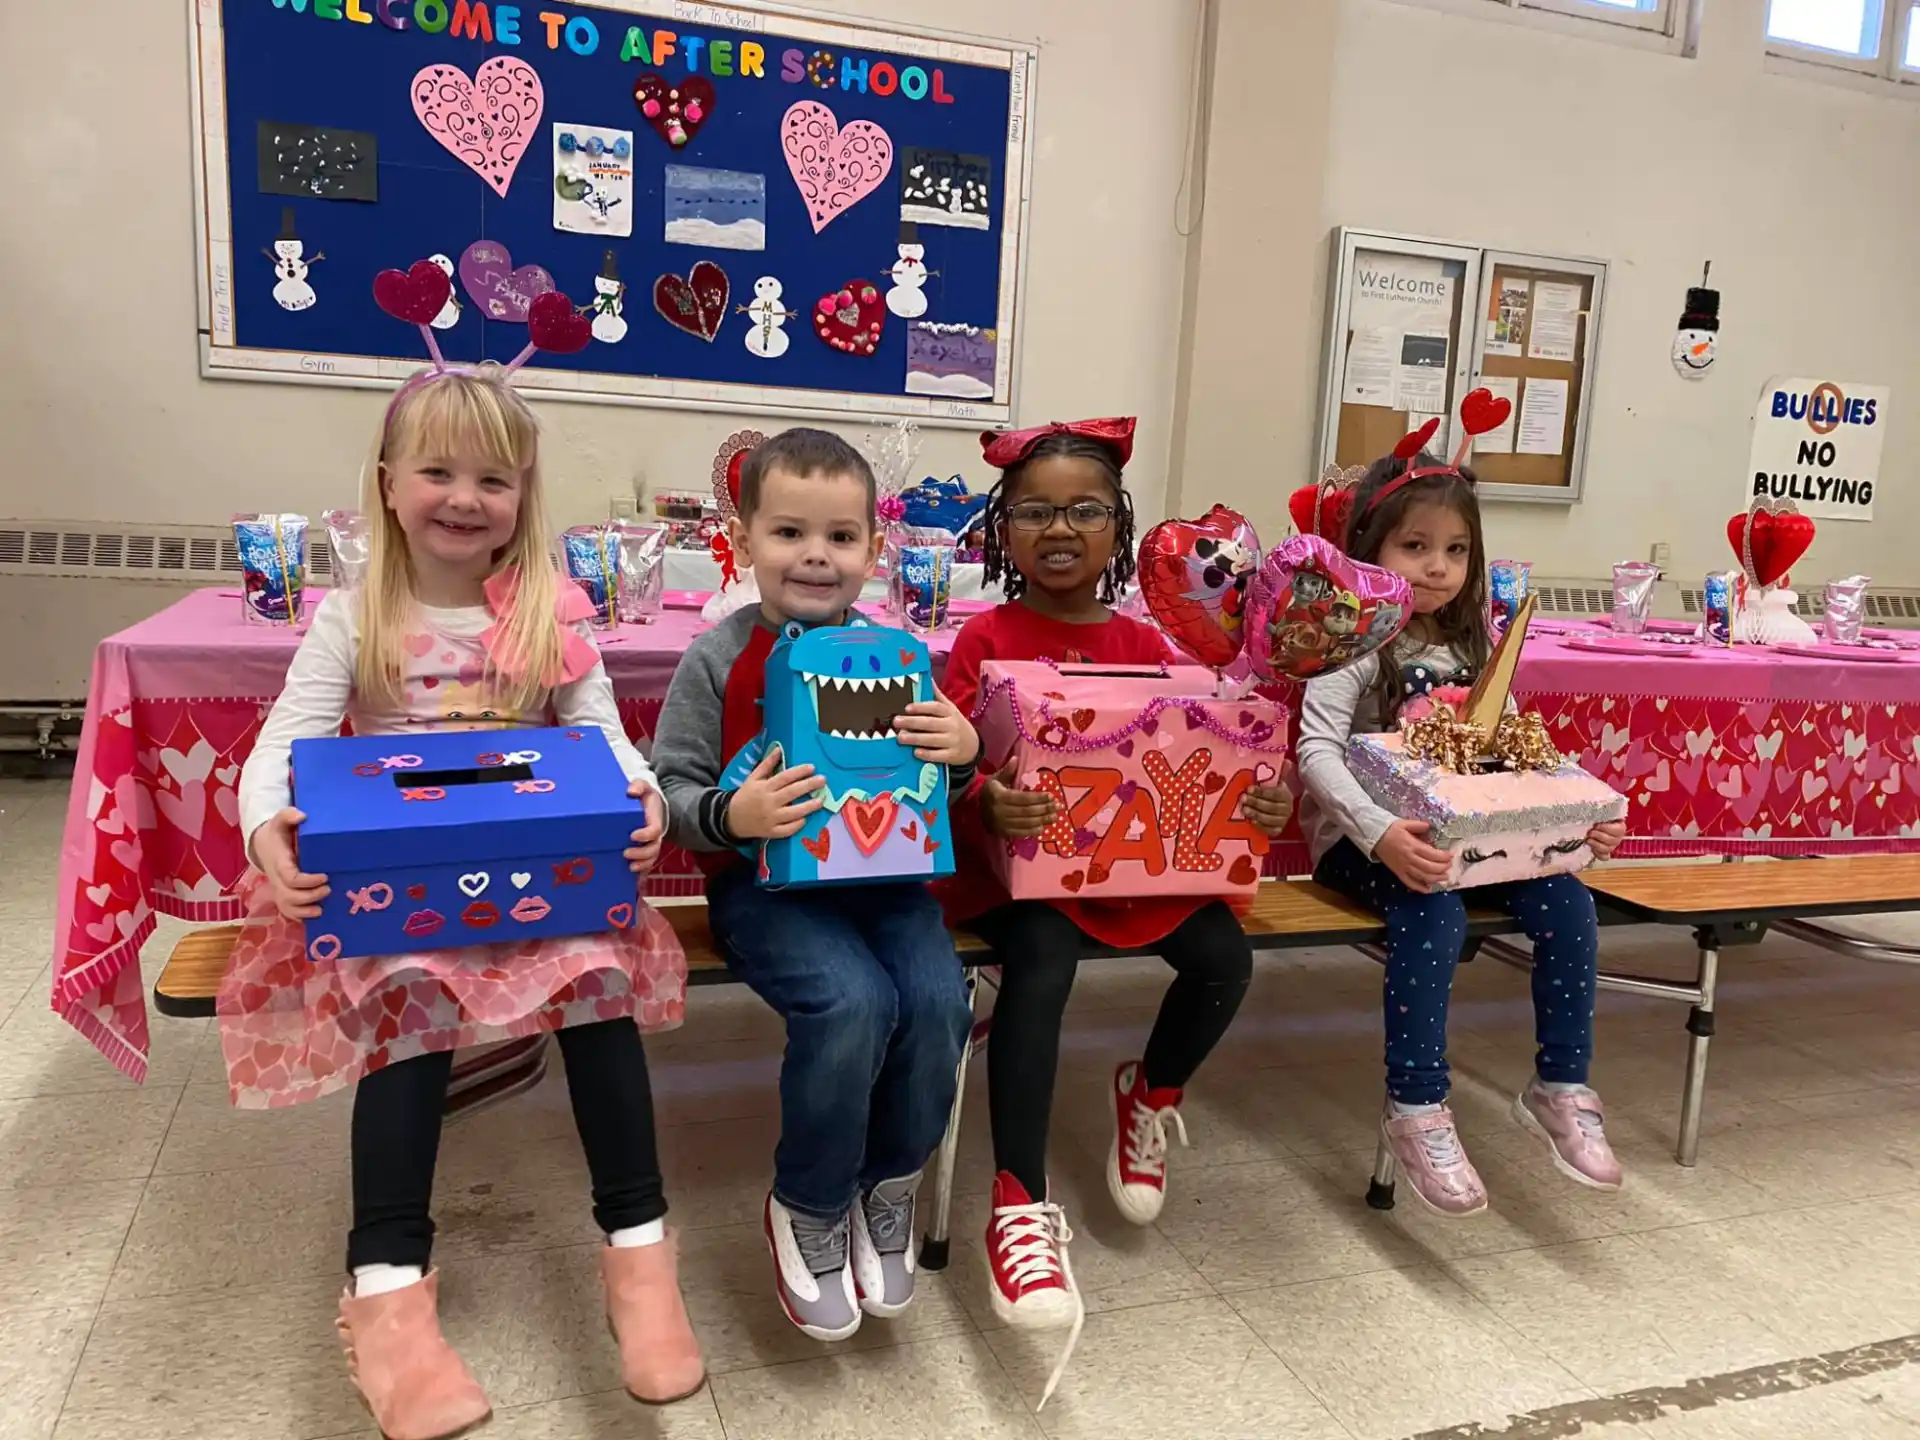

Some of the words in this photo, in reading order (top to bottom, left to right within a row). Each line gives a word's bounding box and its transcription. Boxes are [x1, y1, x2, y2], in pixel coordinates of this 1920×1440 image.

[540, 11, 599, 55] TO
[619, 26, 765, 78] AFTER
[780, 48, 954, 104] SCHOOL
[1359, 270, 1446, 296] Welcome
[1370, 291, 1385, 300] First
[1386, 293, 1416, 303] Lutheran
[300, 355, 336, 373] Gym
[947, 403, 976, 417] Math
[1770, 390, 1877, 426] BULLIES
[1796, 440, 1836, 468] NO
[1753, 471, 1873, 506] BULLYING
